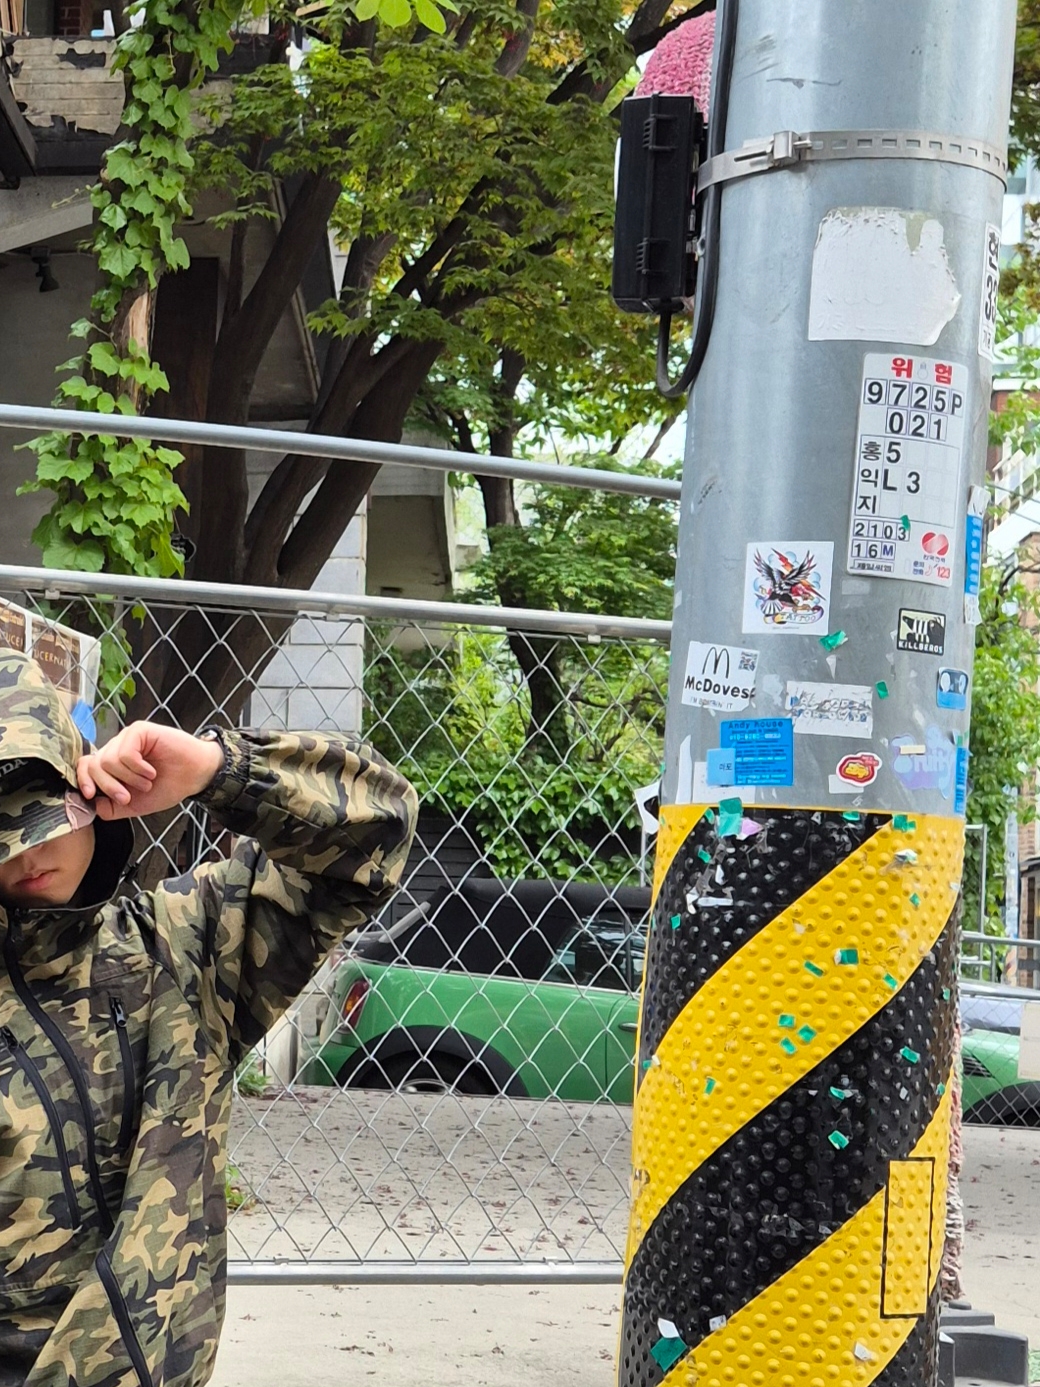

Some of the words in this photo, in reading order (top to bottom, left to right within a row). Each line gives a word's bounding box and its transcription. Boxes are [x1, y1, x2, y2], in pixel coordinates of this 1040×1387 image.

[866, 380, 963, 416] 9725P
[888, 411, 943, 441] 021
[853, 521, 907, 541] 2103
[853, 542, 894, 559] 16M
[936, 565, 951, 579] 123
